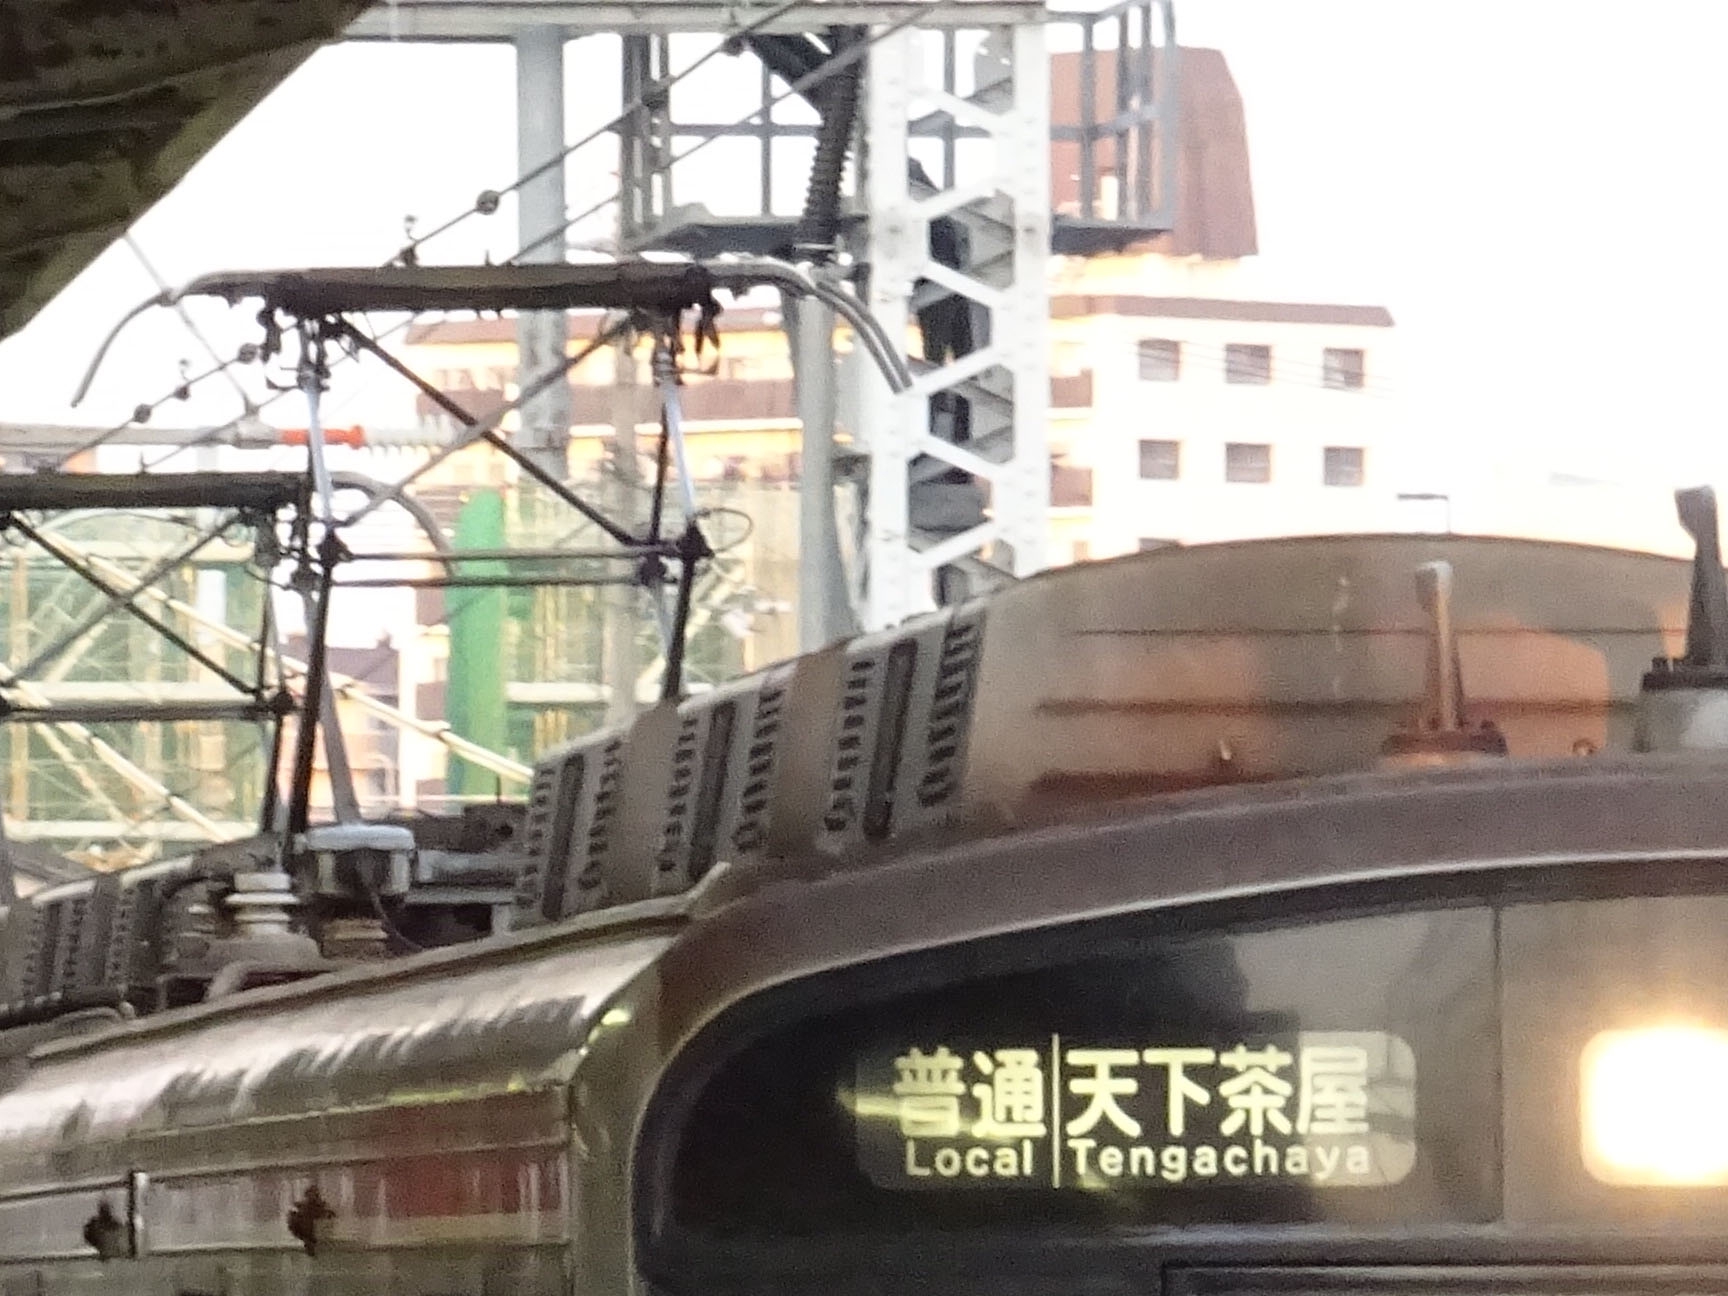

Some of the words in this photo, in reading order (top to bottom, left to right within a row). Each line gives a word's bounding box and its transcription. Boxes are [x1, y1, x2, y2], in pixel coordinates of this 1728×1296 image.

[893, 1046, 1046, 1138] 普通
[1066, 1044, 1369, 1137] 天下茶屋
[905, 1138, 1033, 1177] Local
[1073, 1138, 1370, 1181] Tengachaya
